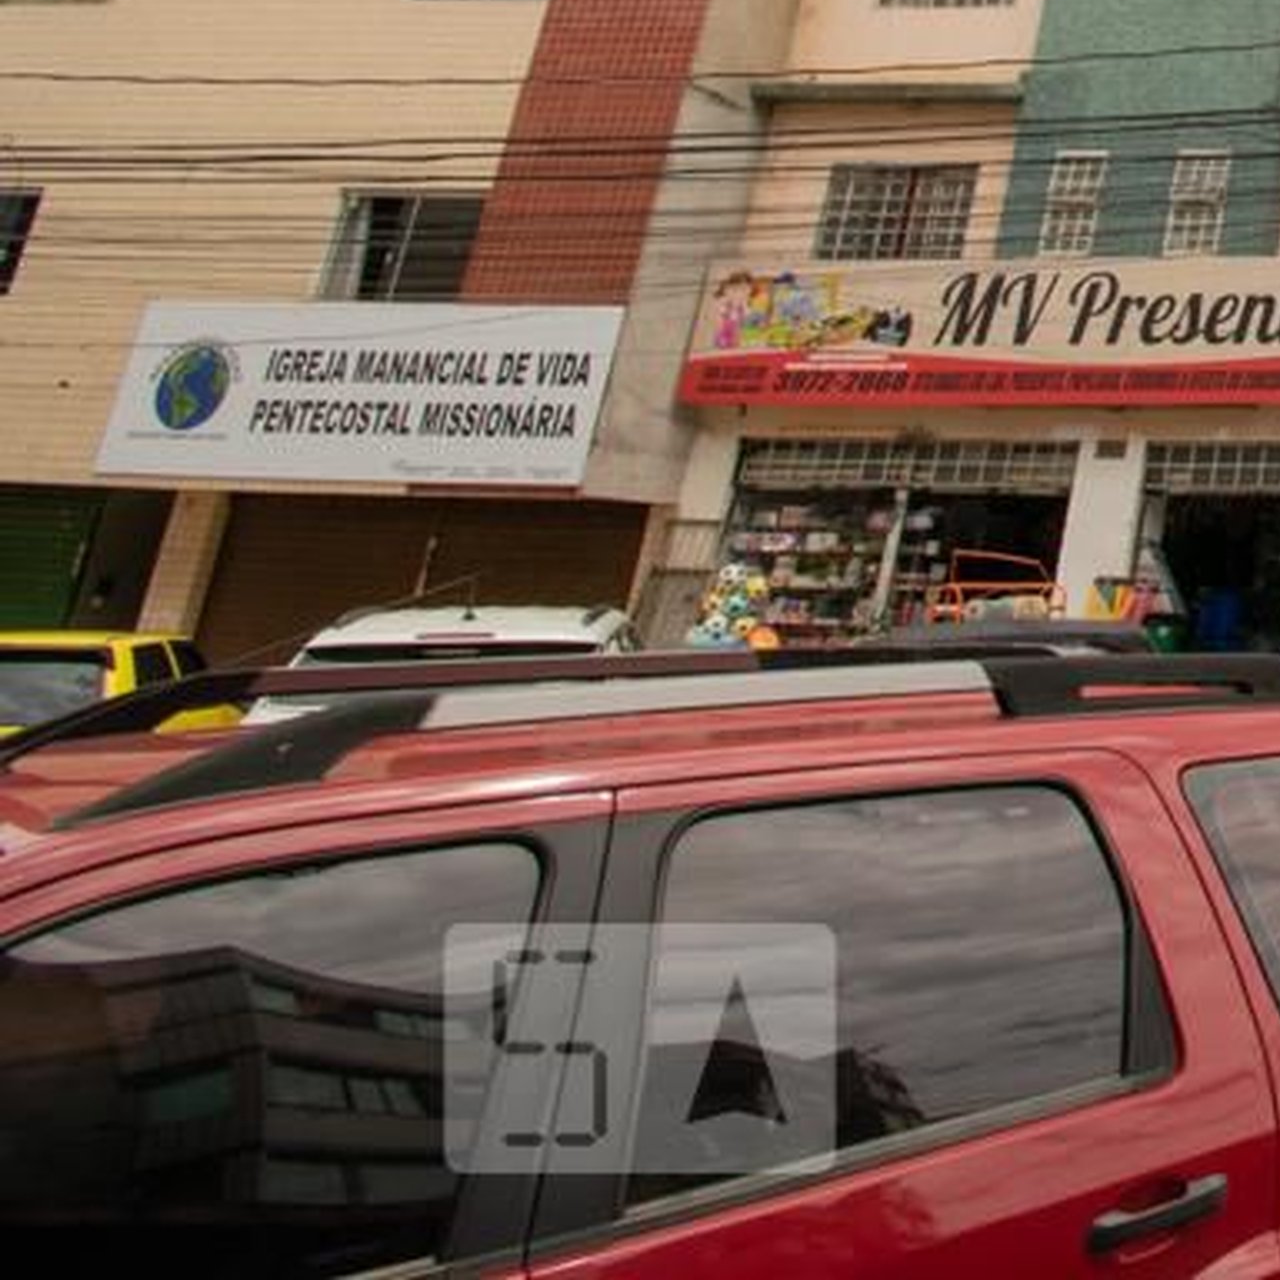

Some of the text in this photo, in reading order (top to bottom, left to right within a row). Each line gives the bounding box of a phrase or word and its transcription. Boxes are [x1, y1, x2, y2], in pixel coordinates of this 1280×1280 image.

[932, 271, 1060, 346] MV
[265, 349, 591, 387] IGREJA MANANCIAL DE VIDA
[250, 394, 575, 439] PENTECOSTAL MISSIONÁRIA
